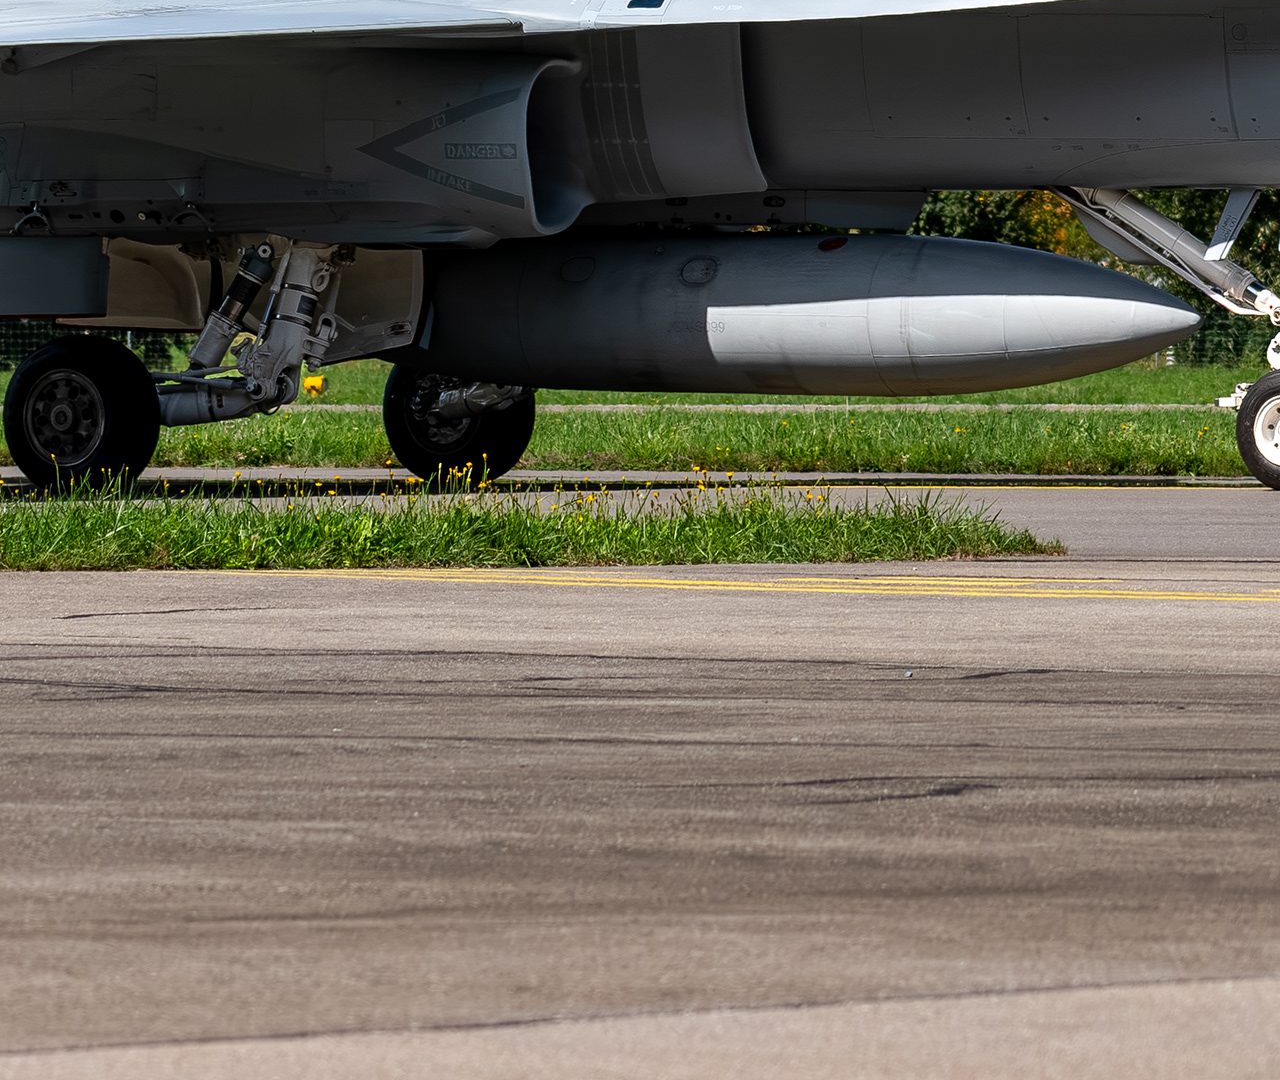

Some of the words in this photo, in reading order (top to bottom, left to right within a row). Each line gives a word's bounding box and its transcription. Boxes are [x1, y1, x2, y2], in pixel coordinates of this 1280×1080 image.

[431, 113, 446, 131] JET
[447, 144, 502, 158] DANGER
[427, 168, 473, 192] INTAKE
